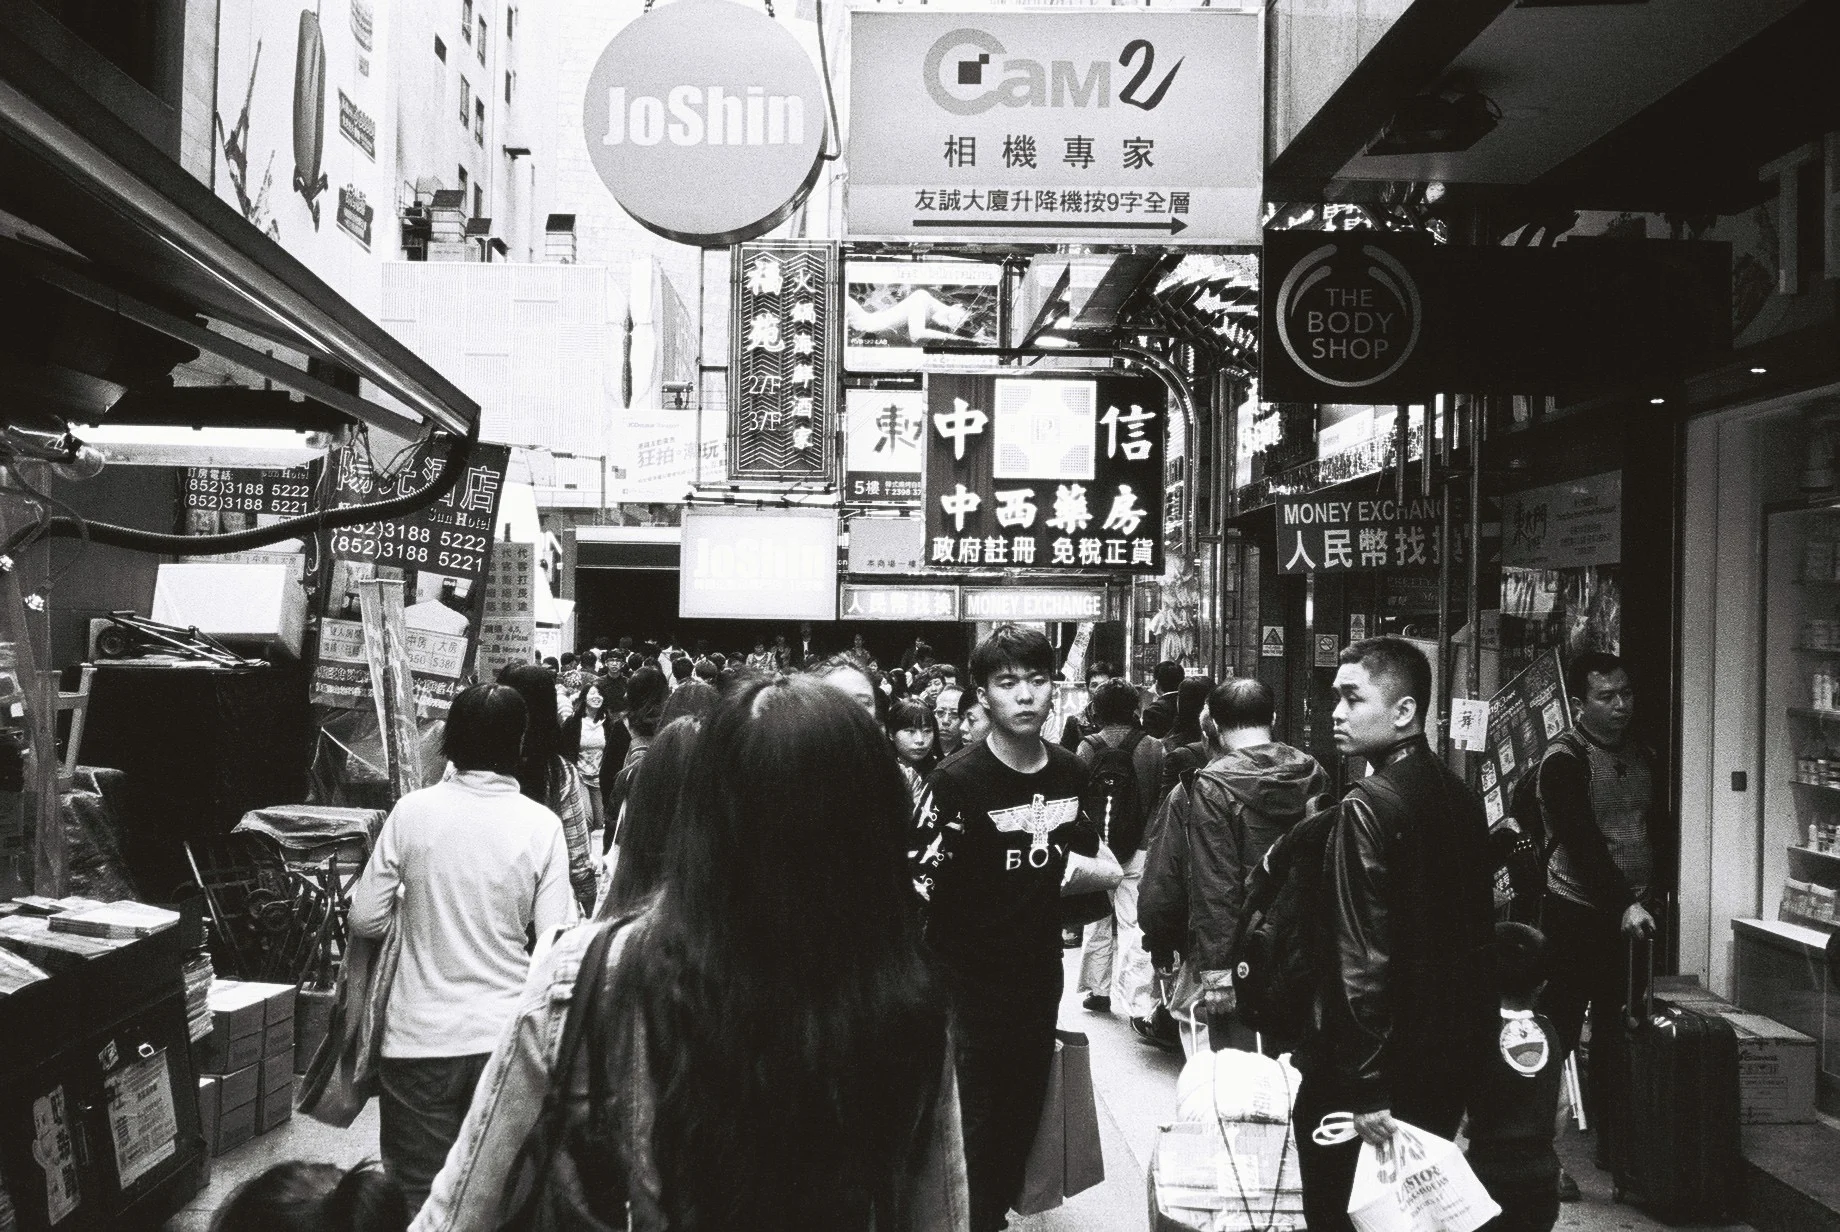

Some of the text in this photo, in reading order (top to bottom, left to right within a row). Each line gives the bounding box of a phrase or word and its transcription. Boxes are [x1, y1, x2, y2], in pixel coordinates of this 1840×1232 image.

[602, 84, 804, 147] JoShin
[943, 134, 1156, 171] 相機專家
[913, 188, 1191, 216] 友誠大廈升降機按9字全層
[1325, 288, 1374, 307] THE
[1308, 311, 1394, 334] BODY
[1312, 338, 1389, 359] SHOP
[749, 375, 783, 395] 2/F
[749, 411, 783, 431] 3/F
[282, 469, 309, 480] Hotel
[184, 478, 309, 498] (852)3188 5222
[183, 494, 308, 513] (852)3188 5221
[941, 484, 1147, 535] 中西藥房
[1284, 502, 1352, 525] MONEY
[428, 508, 491, 530] Sun Hotel
[440, 531, 487, 552] 5222
[932, 536, 1154, 565] 政府註冊 免稅正貨
[330, 535, 482, 572] (852)3188 5221
[694, 538, 826, 579] JoShin
[967, 594, 1101, 616] MONEY EXCHANGE
